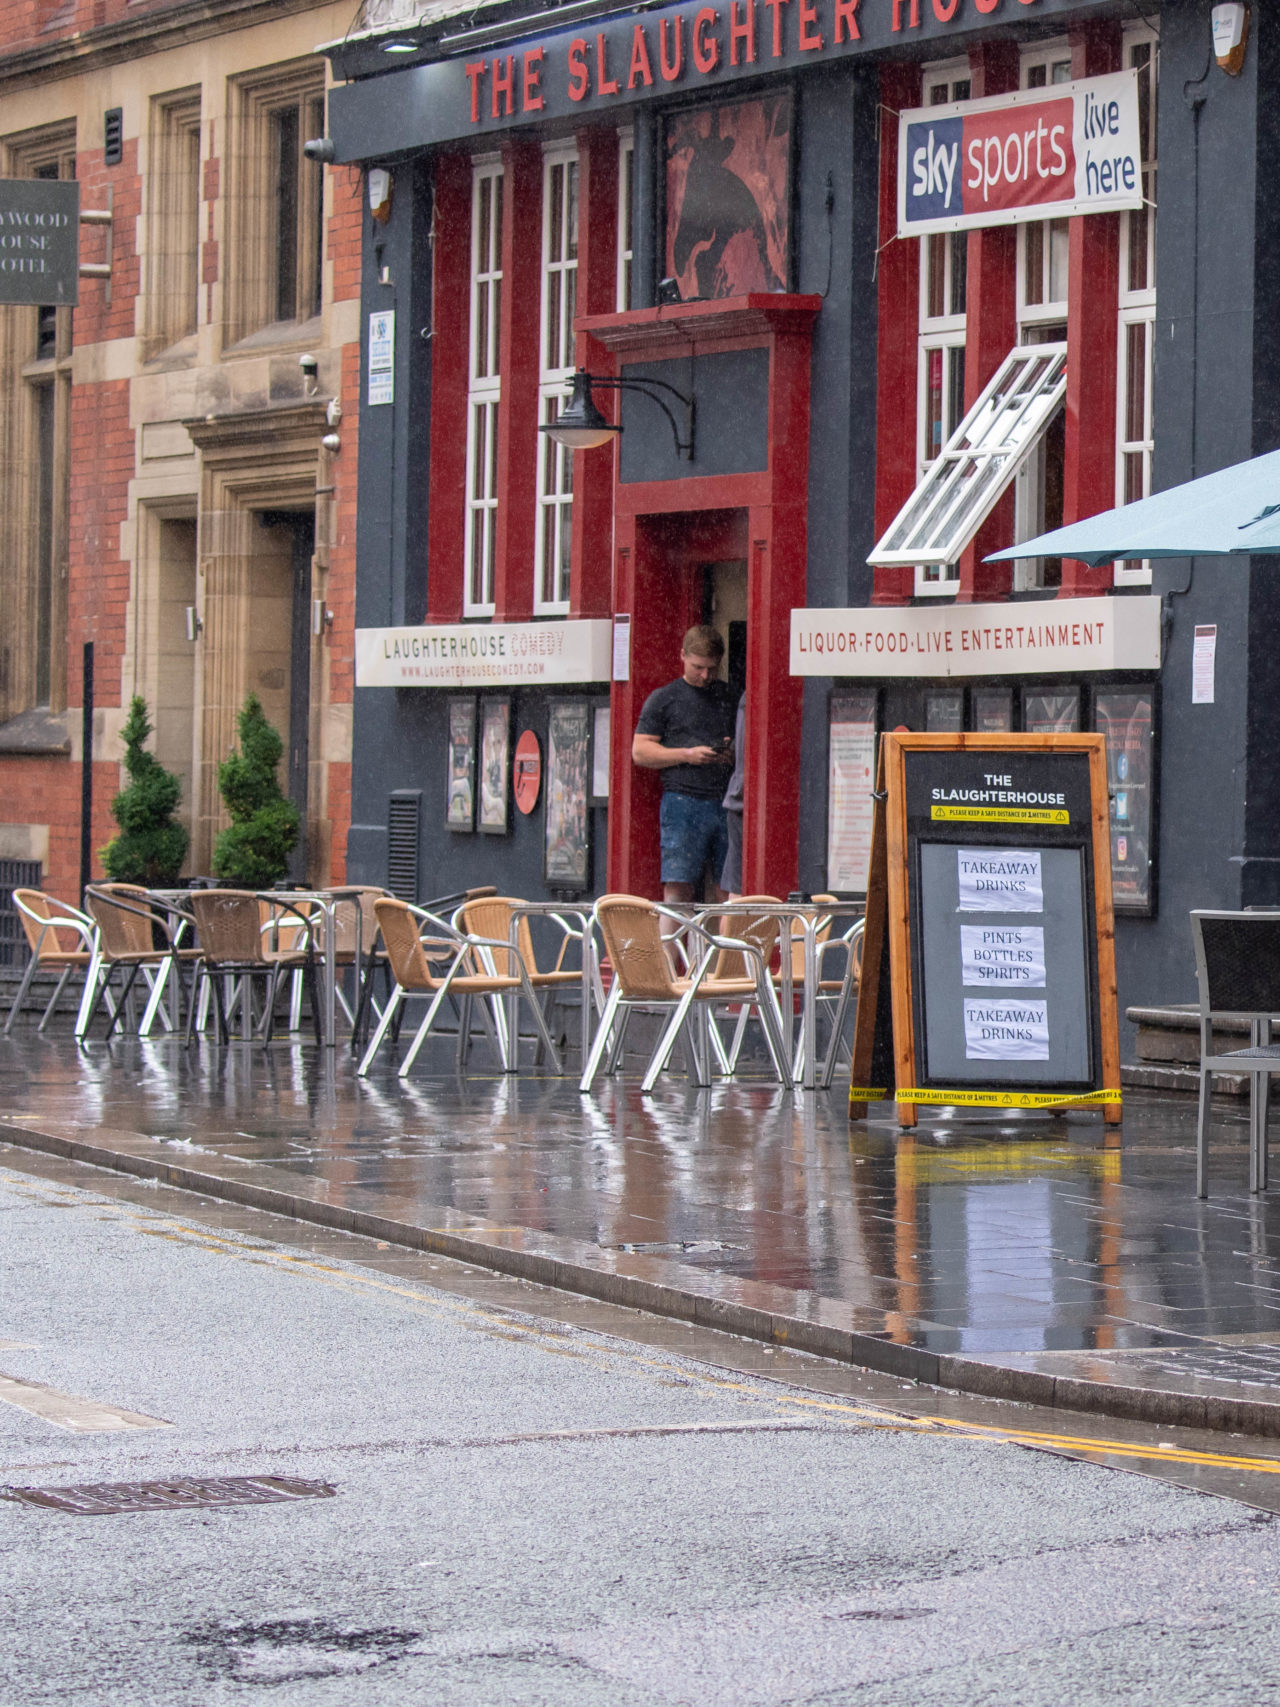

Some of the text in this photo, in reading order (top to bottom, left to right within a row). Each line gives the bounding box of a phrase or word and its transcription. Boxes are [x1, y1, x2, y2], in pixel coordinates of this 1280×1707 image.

[465, 0, 861, 122] THE SLAUGHTER
[1084, 92, 1119, 140] live
[912, 118, 1066, 208] sky sports
[1086, 150, 1135, 196] here
[1, 235, 51, 250] OUSE
[1, 259, 51, 273] OTEL
[961, 623, 1104, 650] ENTERTAINMENT
[384, 635, 506, 659] LAUGHTERHOUSE
[984, 774, 1012, 787] THE
[932, 788, 1065, 804] SLAUGHTERHOUSE
[961, 860, 1038, 875] TAKEAWAY
[975, 879, 1027, 892] DRINKS
[983, 931, 1022, 944] PINTS
[973, 949, 1033, 963] BOTTLES
[978, 966, 1030, 980] SPIRITS
[966, 1008, 1045, 1023] TAKEAWAY
[981, 1027, 1033, 1040] DRINKS
[914, 1091, 925, 1099] KEEP
